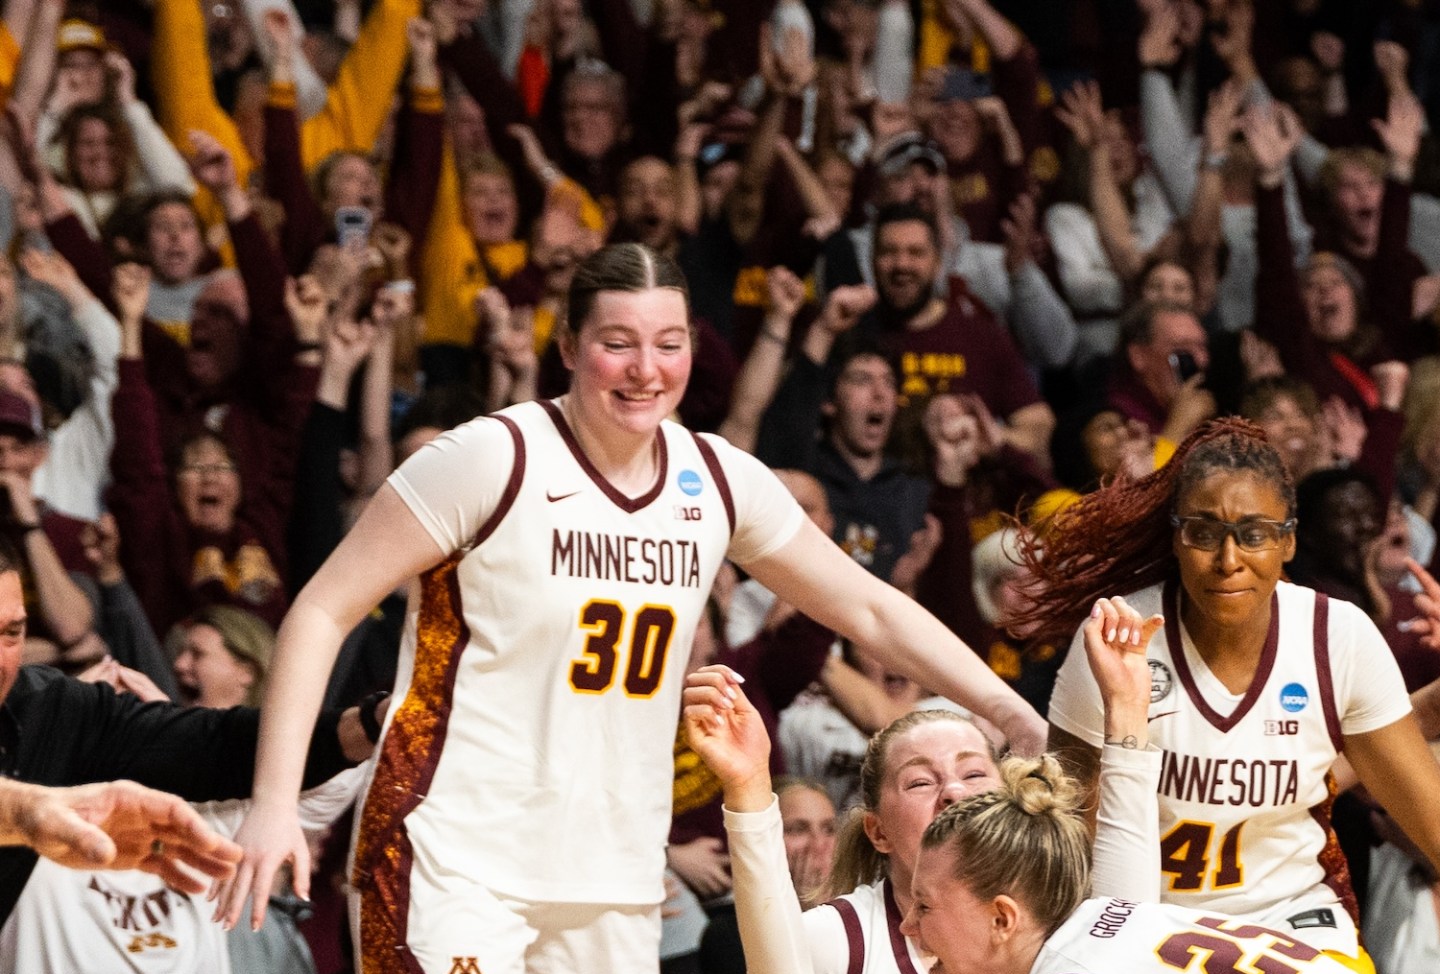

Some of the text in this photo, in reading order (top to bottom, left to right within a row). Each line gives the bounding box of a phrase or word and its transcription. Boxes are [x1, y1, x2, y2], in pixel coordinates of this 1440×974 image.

[551, 528, 700, 588] MINNESOTA
[568, 598, 677, 700] 30
[1156, 749, 1298, 807] INNESOTA
[1161, 818, 1249, 892] 41
[1089, 896, 1142, 939] GROCK
